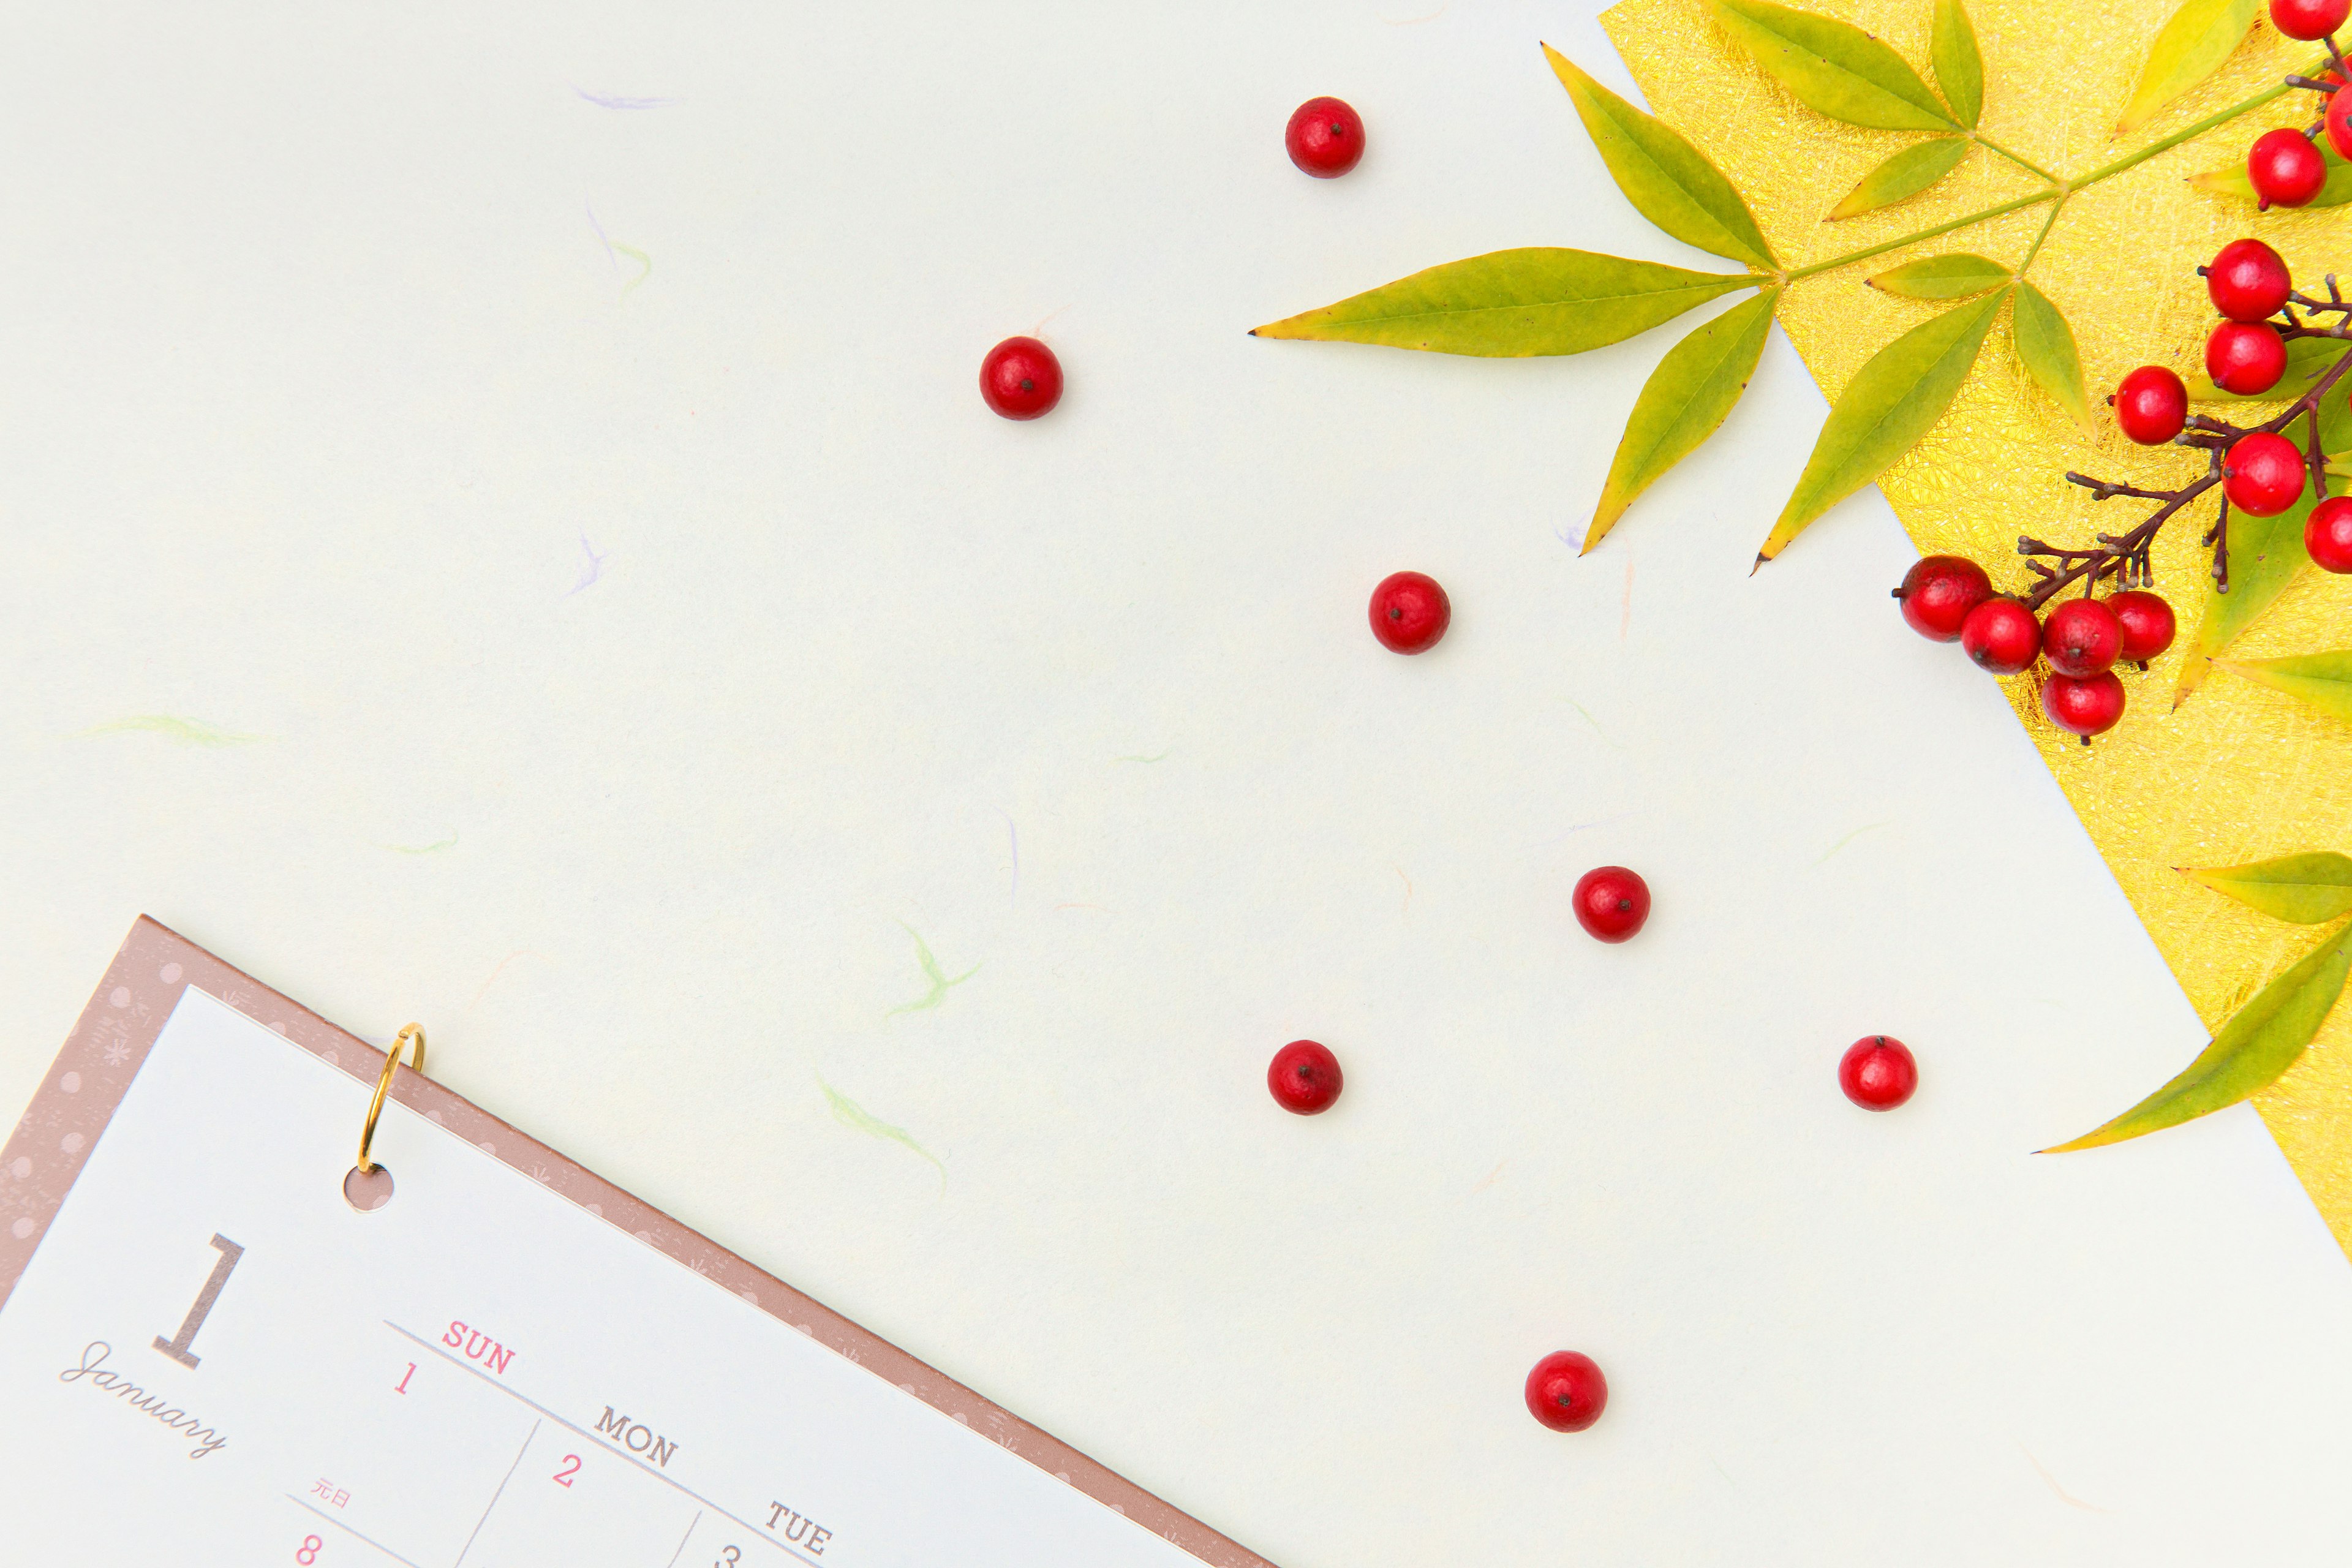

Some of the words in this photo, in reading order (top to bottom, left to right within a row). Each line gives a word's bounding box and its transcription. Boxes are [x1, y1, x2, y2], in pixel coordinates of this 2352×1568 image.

[151, 1232, 246, 1371] 1
[59, 1341, 227, 1460] January
[394, 1362, 418, 1395] 1
[552, 1453, 582, 1488] 2
[714, 1545, 742, 1568] 3
[442, 1320, 516, 1375] SUN
[594, 1405, 679, 1468] MON
[766, 1500, 833, 1557] TUE
[295, 1534, 323, 1567] 8
[310, 1477, 351, 1509] 元日
